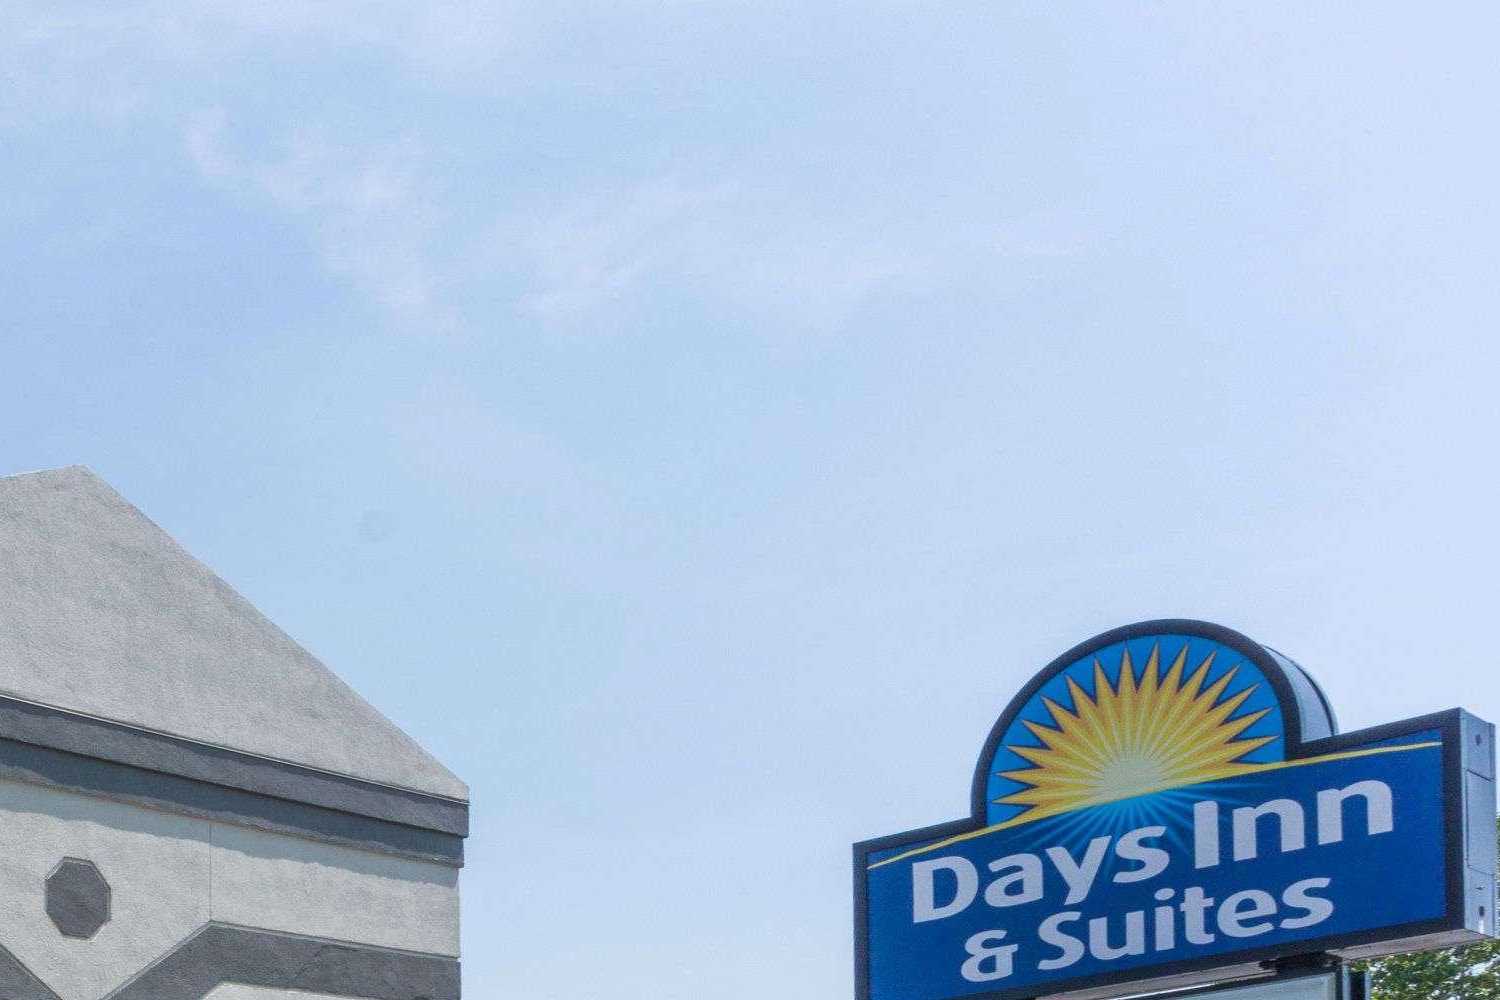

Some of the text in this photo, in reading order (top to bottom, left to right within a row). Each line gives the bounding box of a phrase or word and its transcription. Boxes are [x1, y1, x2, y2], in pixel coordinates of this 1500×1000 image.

[913, 779, 1394, 922] Days Inn
[961, 877, 1335, 982] & Suites
